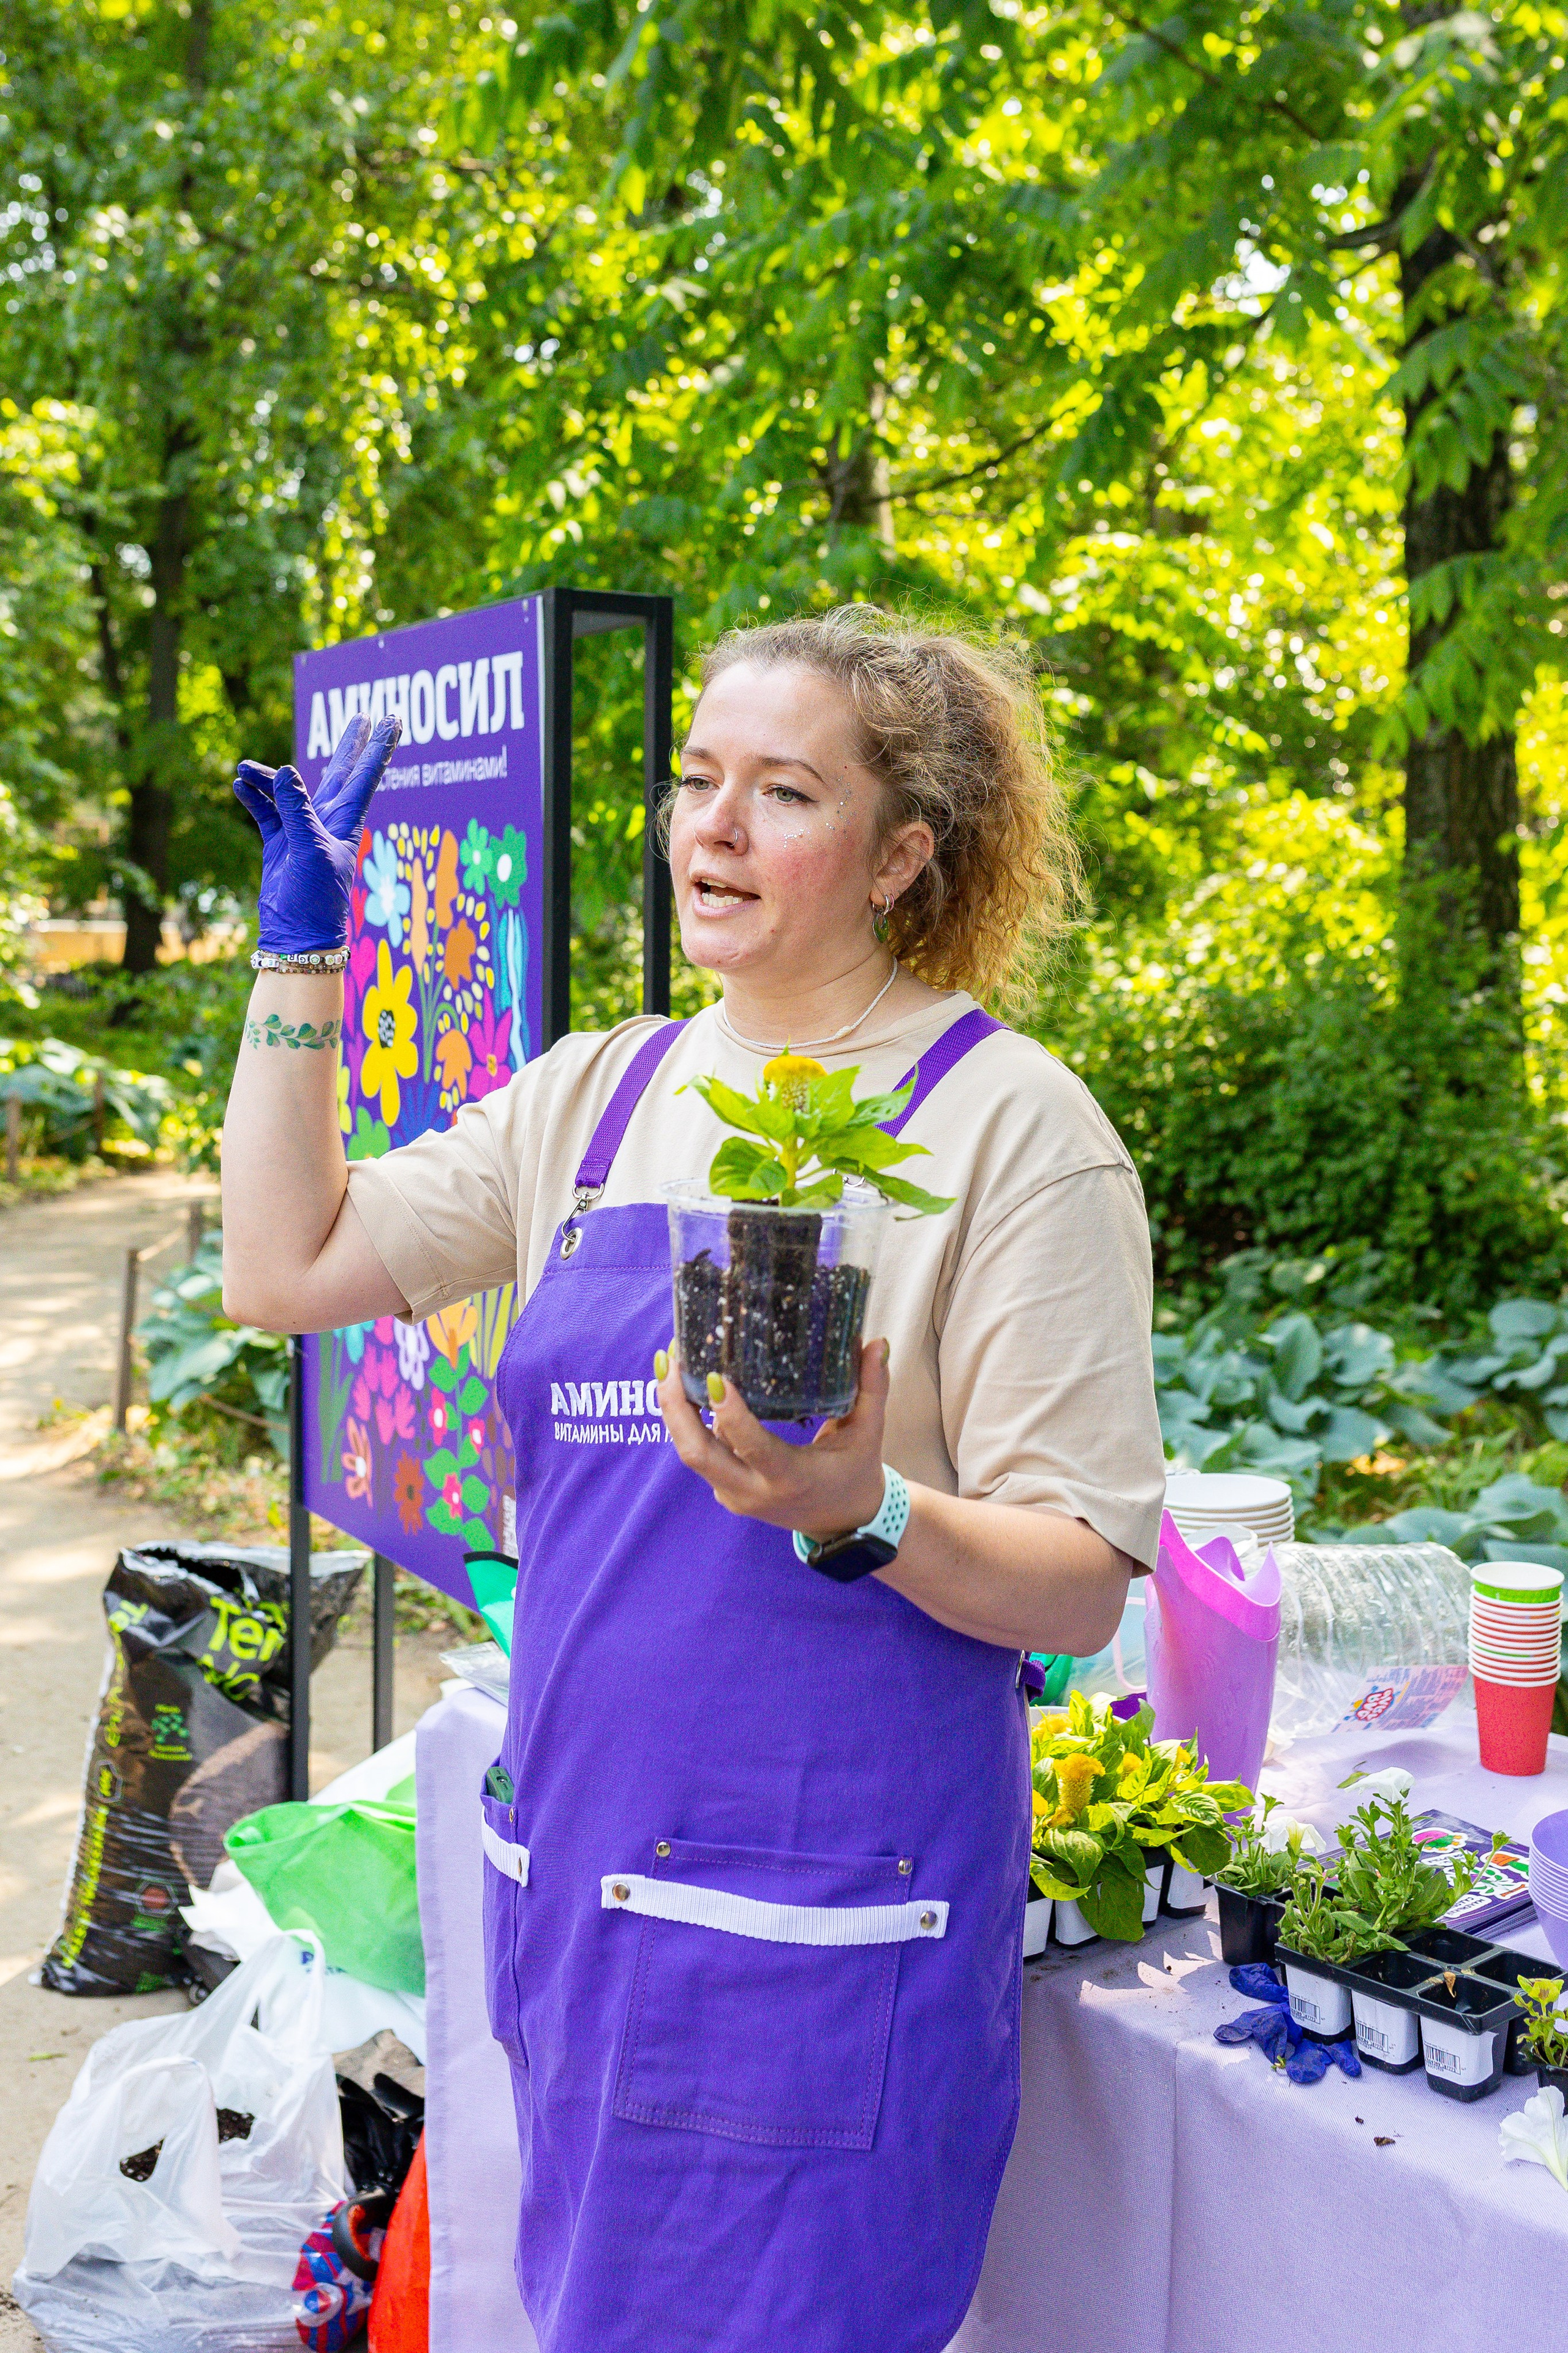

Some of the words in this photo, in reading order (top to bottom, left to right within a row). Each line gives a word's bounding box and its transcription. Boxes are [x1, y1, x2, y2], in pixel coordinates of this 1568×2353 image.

[306, 651, 525, 760] АМИНОСИЛ
[421, 744, 507, 787] витаминами!
[554, 1421, 624, 1444] ВИТАМИНЫ
[627, 1422, 660, 1445] ДЛЯ
